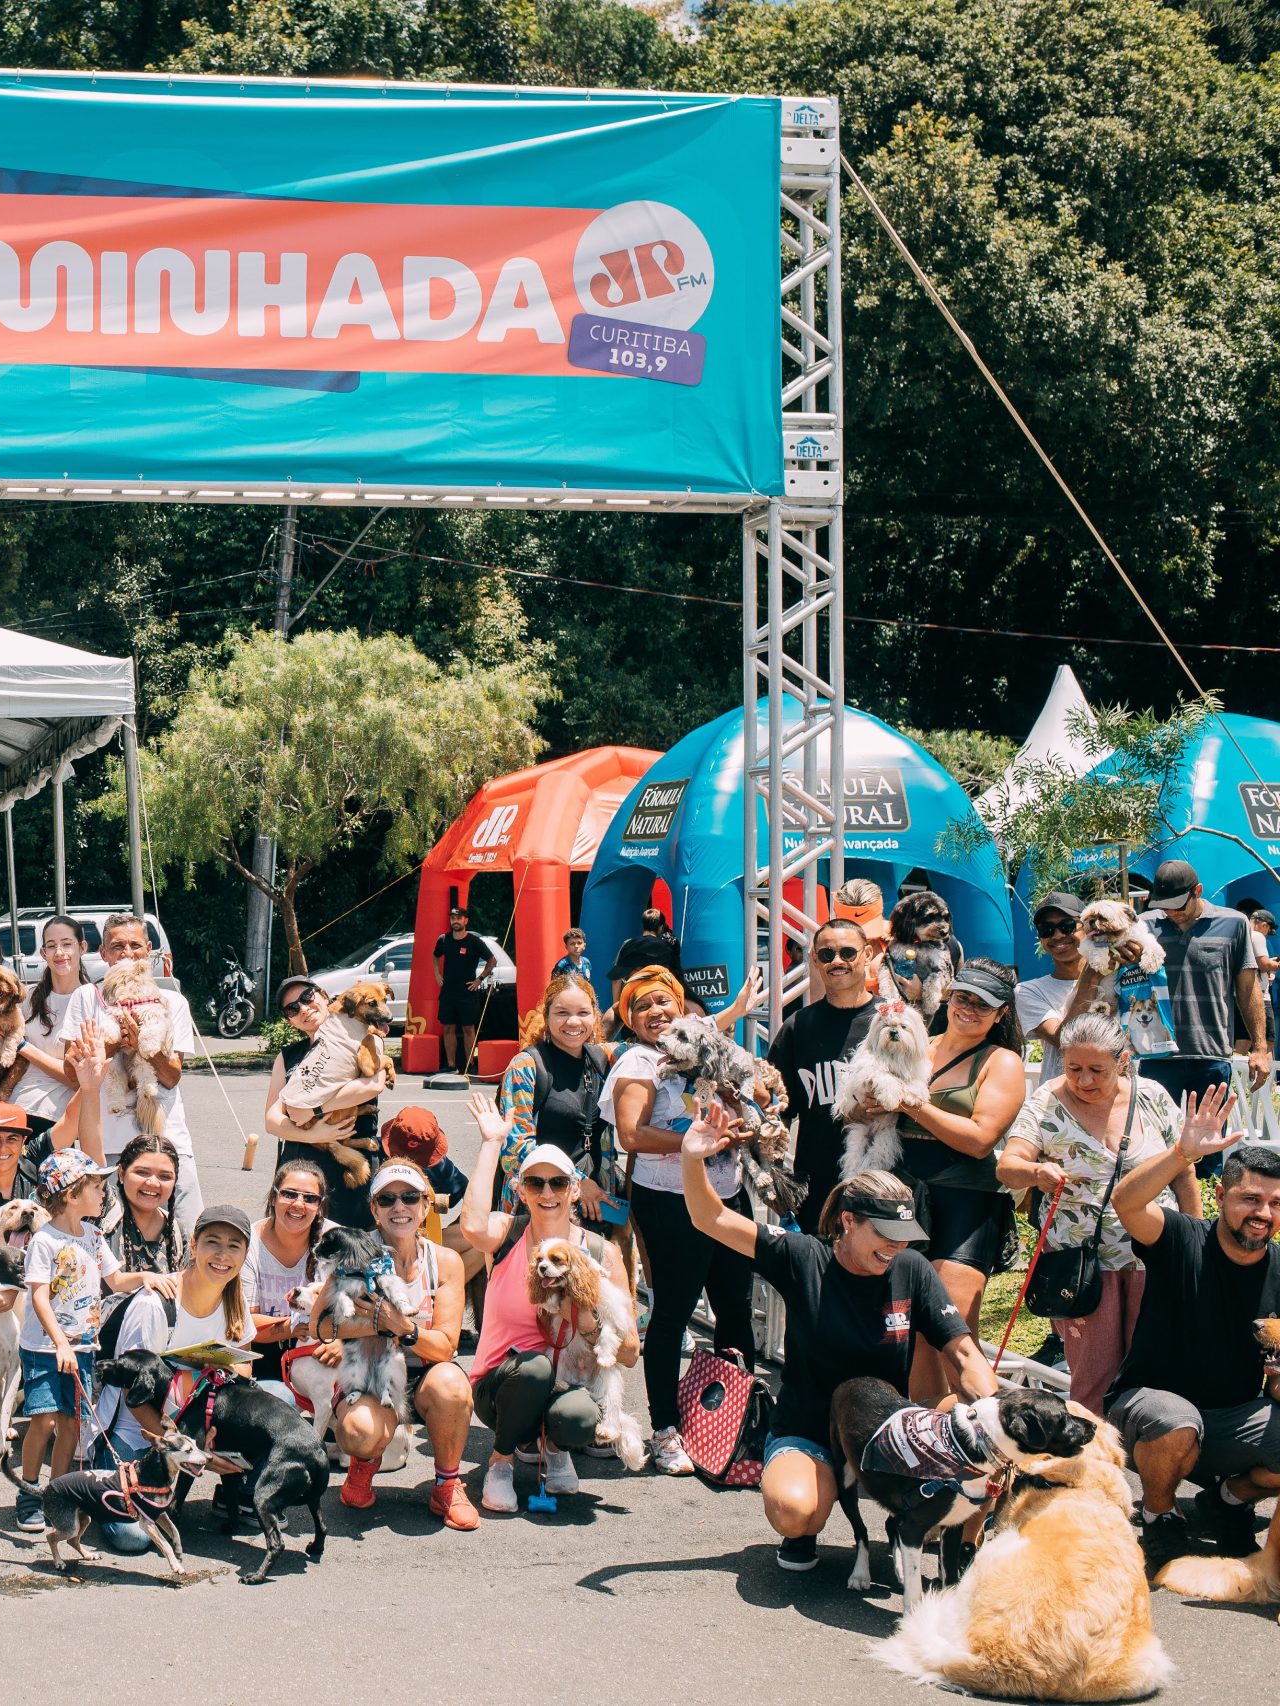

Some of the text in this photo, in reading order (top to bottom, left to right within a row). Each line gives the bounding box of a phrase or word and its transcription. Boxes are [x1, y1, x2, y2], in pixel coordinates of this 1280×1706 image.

[793, 112, 819, 126] DELTA
[677, 272, 707, 291] FM
[590, 325, 691, 357] CURITIBA
[609, 348, 668, 373] 103,9
[796, 445, 823, 458] DELTA
[638, 784, 686, 808] FÓRMULA
[626, 811, 674, 835] NATURAL
